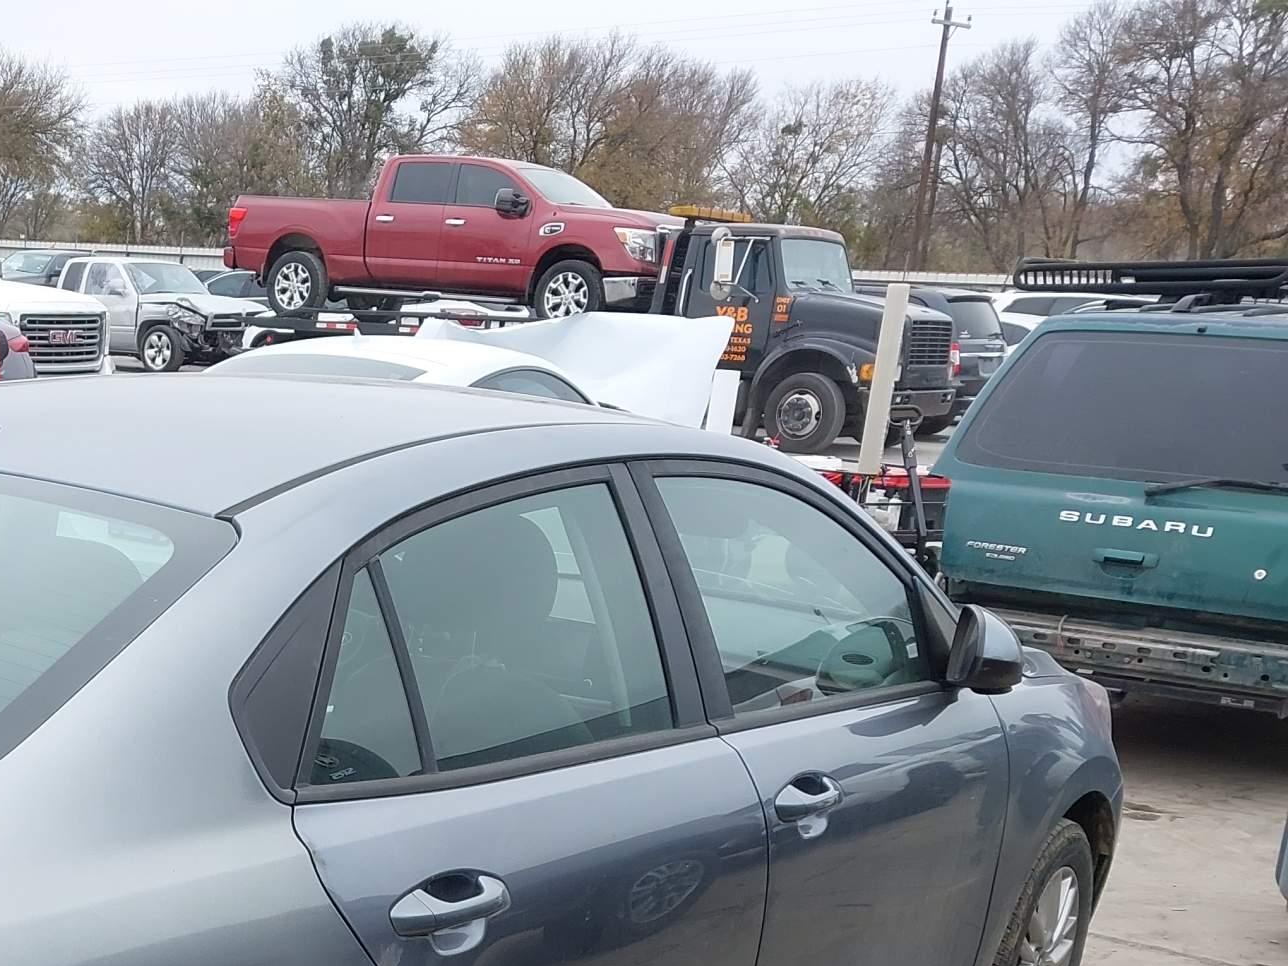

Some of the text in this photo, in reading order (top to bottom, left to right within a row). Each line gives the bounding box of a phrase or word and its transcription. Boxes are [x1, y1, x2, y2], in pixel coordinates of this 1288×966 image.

[476, 256, 506, 264] TITAN
[776, 304, 787, 313] 01
[49, 329, 85, 345] GMC
[1058, 510, 1214, 538] SUBARU
[966, 540, 1027, 554] FORESTER
